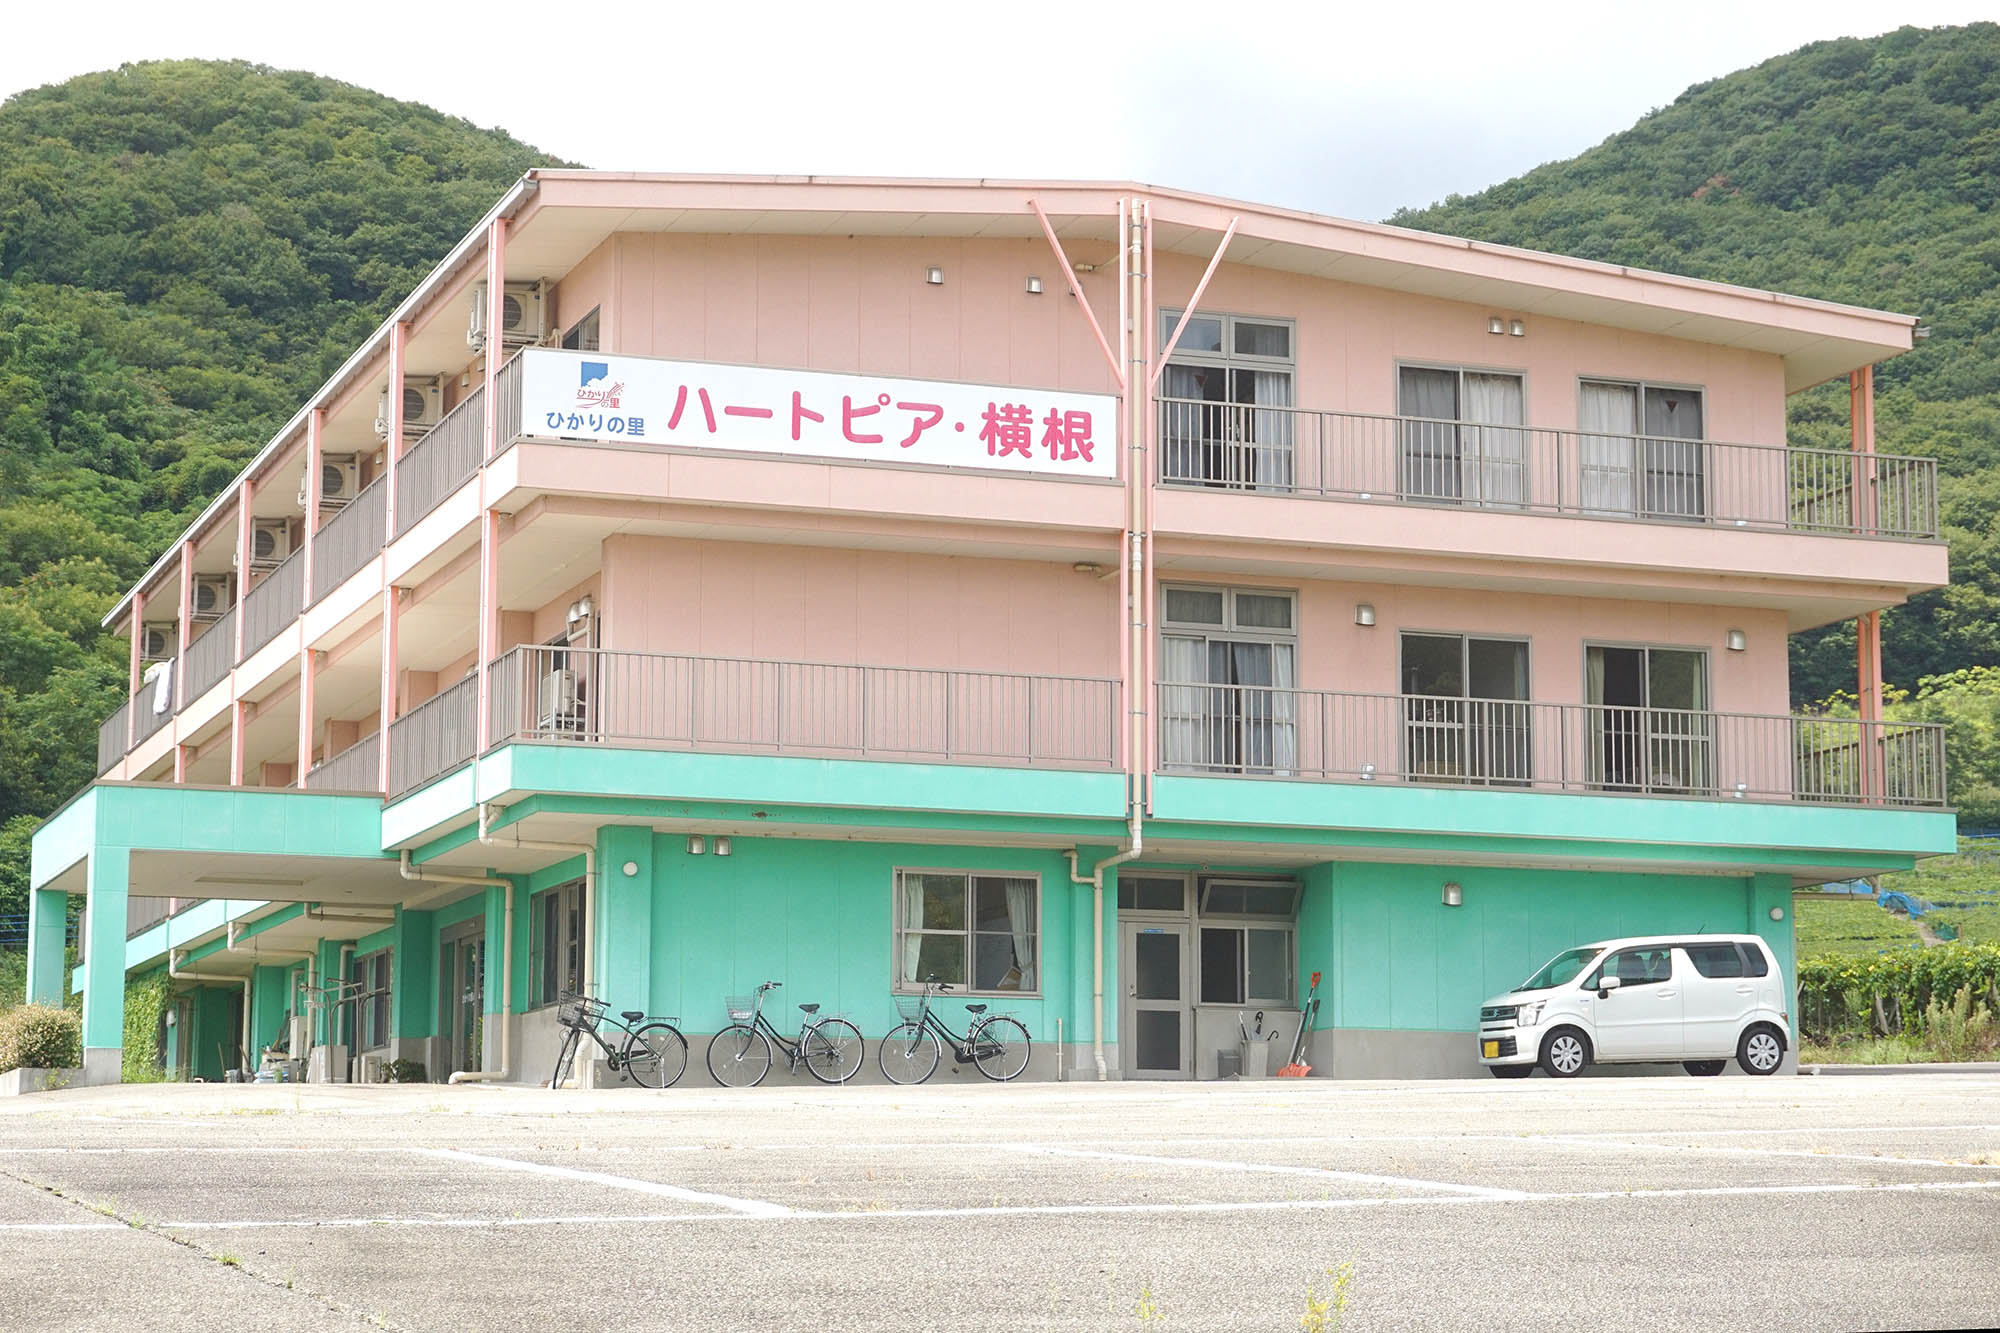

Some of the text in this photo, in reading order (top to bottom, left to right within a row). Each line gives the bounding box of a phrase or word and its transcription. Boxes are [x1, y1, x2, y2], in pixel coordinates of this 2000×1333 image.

[546, 411, 645, 436] ひかりの里
[668, 385, 1094, 462] ハートピア・横根
